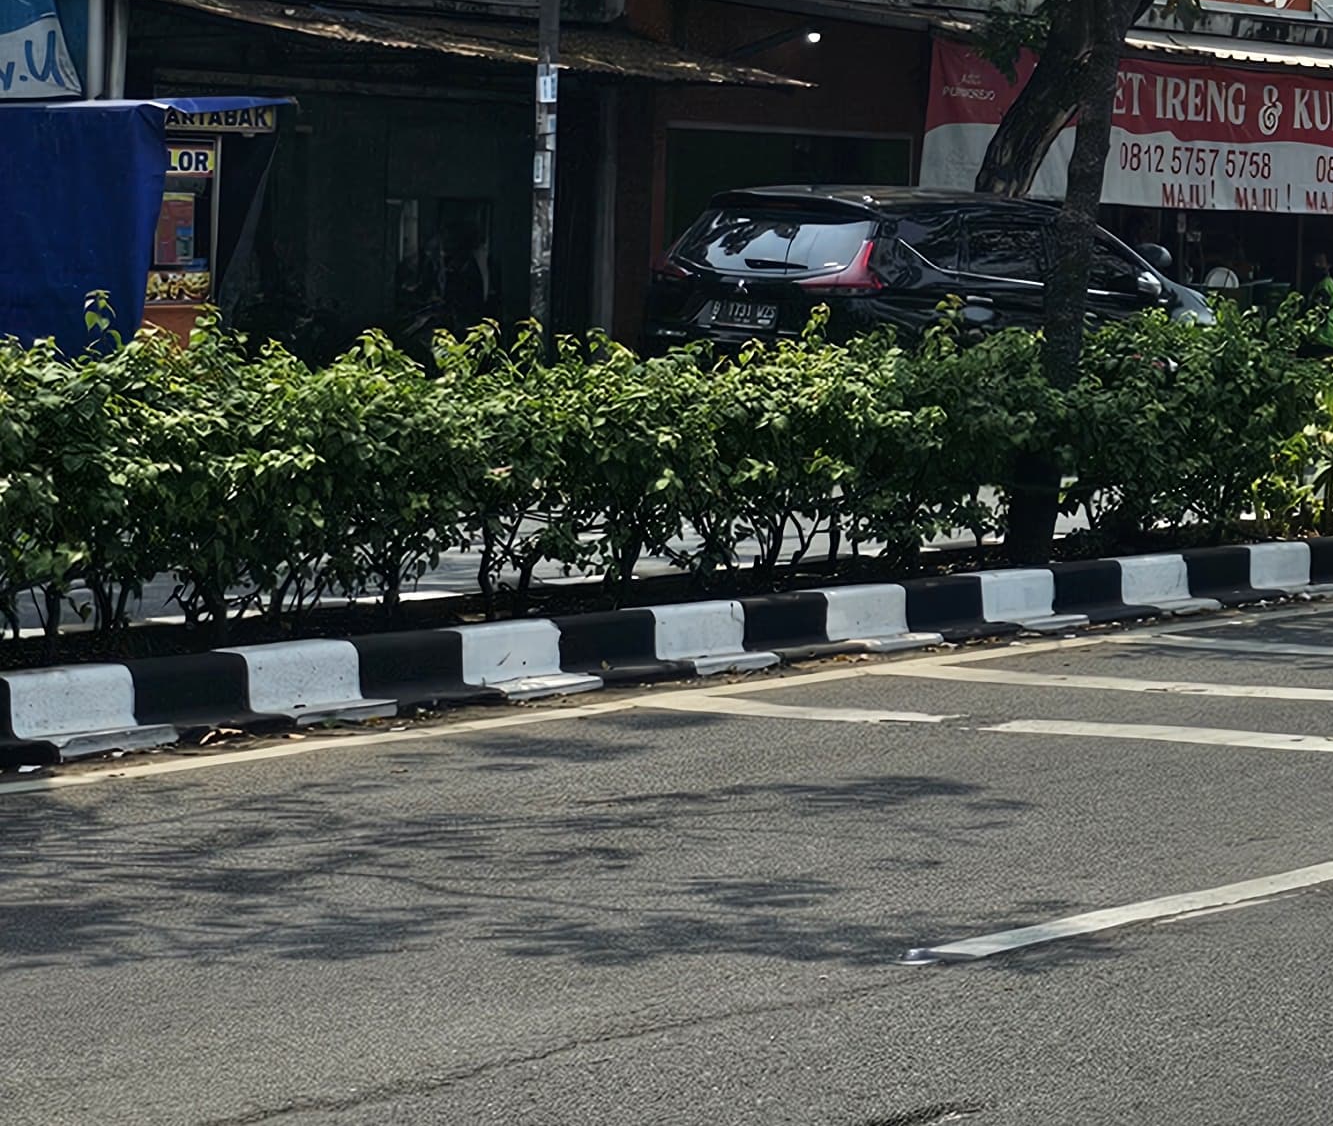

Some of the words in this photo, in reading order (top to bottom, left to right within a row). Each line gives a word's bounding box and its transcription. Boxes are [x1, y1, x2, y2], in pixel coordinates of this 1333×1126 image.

[1155, 76, 1246, 125] IRENG
[1258, 85, 1283, 136] &
[1119, 141, 1165, 172] 0812
[1170, 146, 1219, 175] 5757
[1225, 150, 1272, 179] 5758
